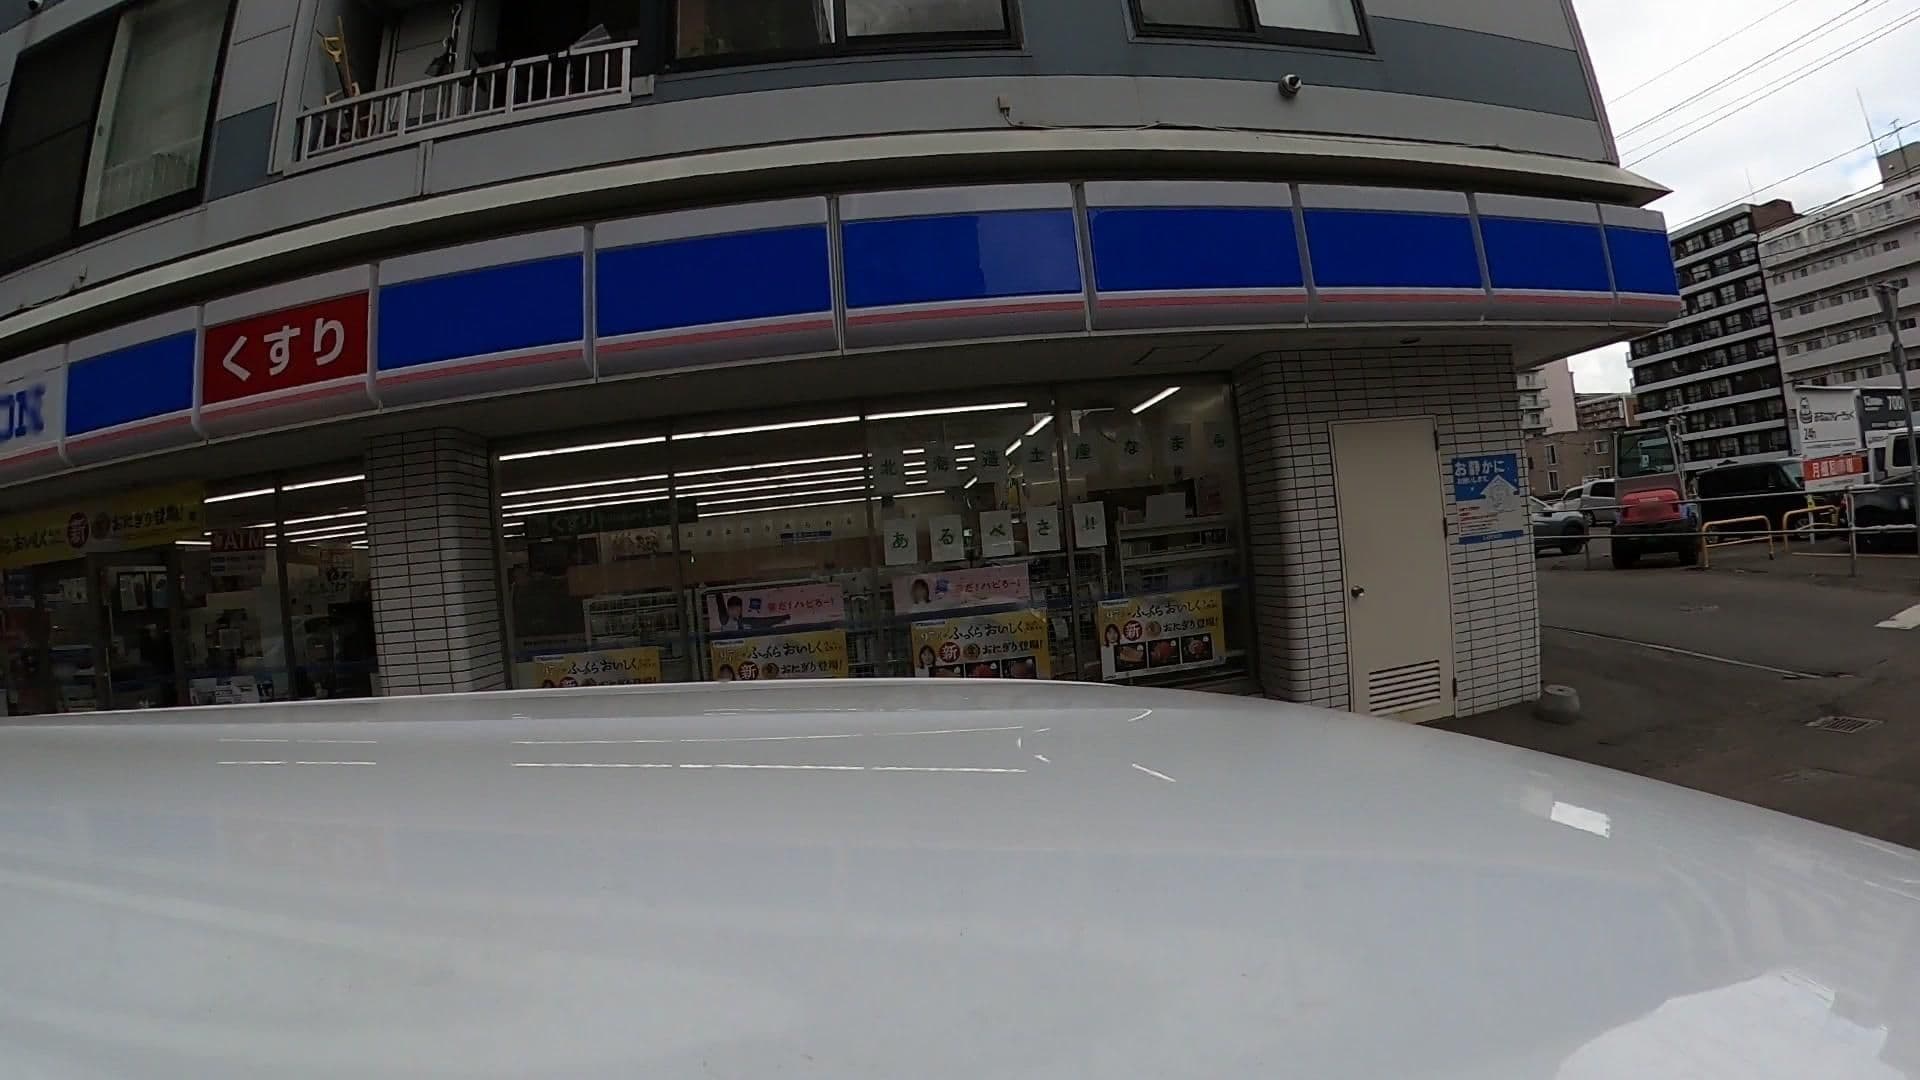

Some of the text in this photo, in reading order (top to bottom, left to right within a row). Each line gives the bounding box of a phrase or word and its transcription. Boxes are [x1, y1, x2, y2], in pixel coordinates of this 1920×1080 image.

[222, 317, 345, 382] くすり
[1124, 622, 1141, 640] 新
[942, 644, 959, 661] 新
[740, 664, 758, 680] 新
